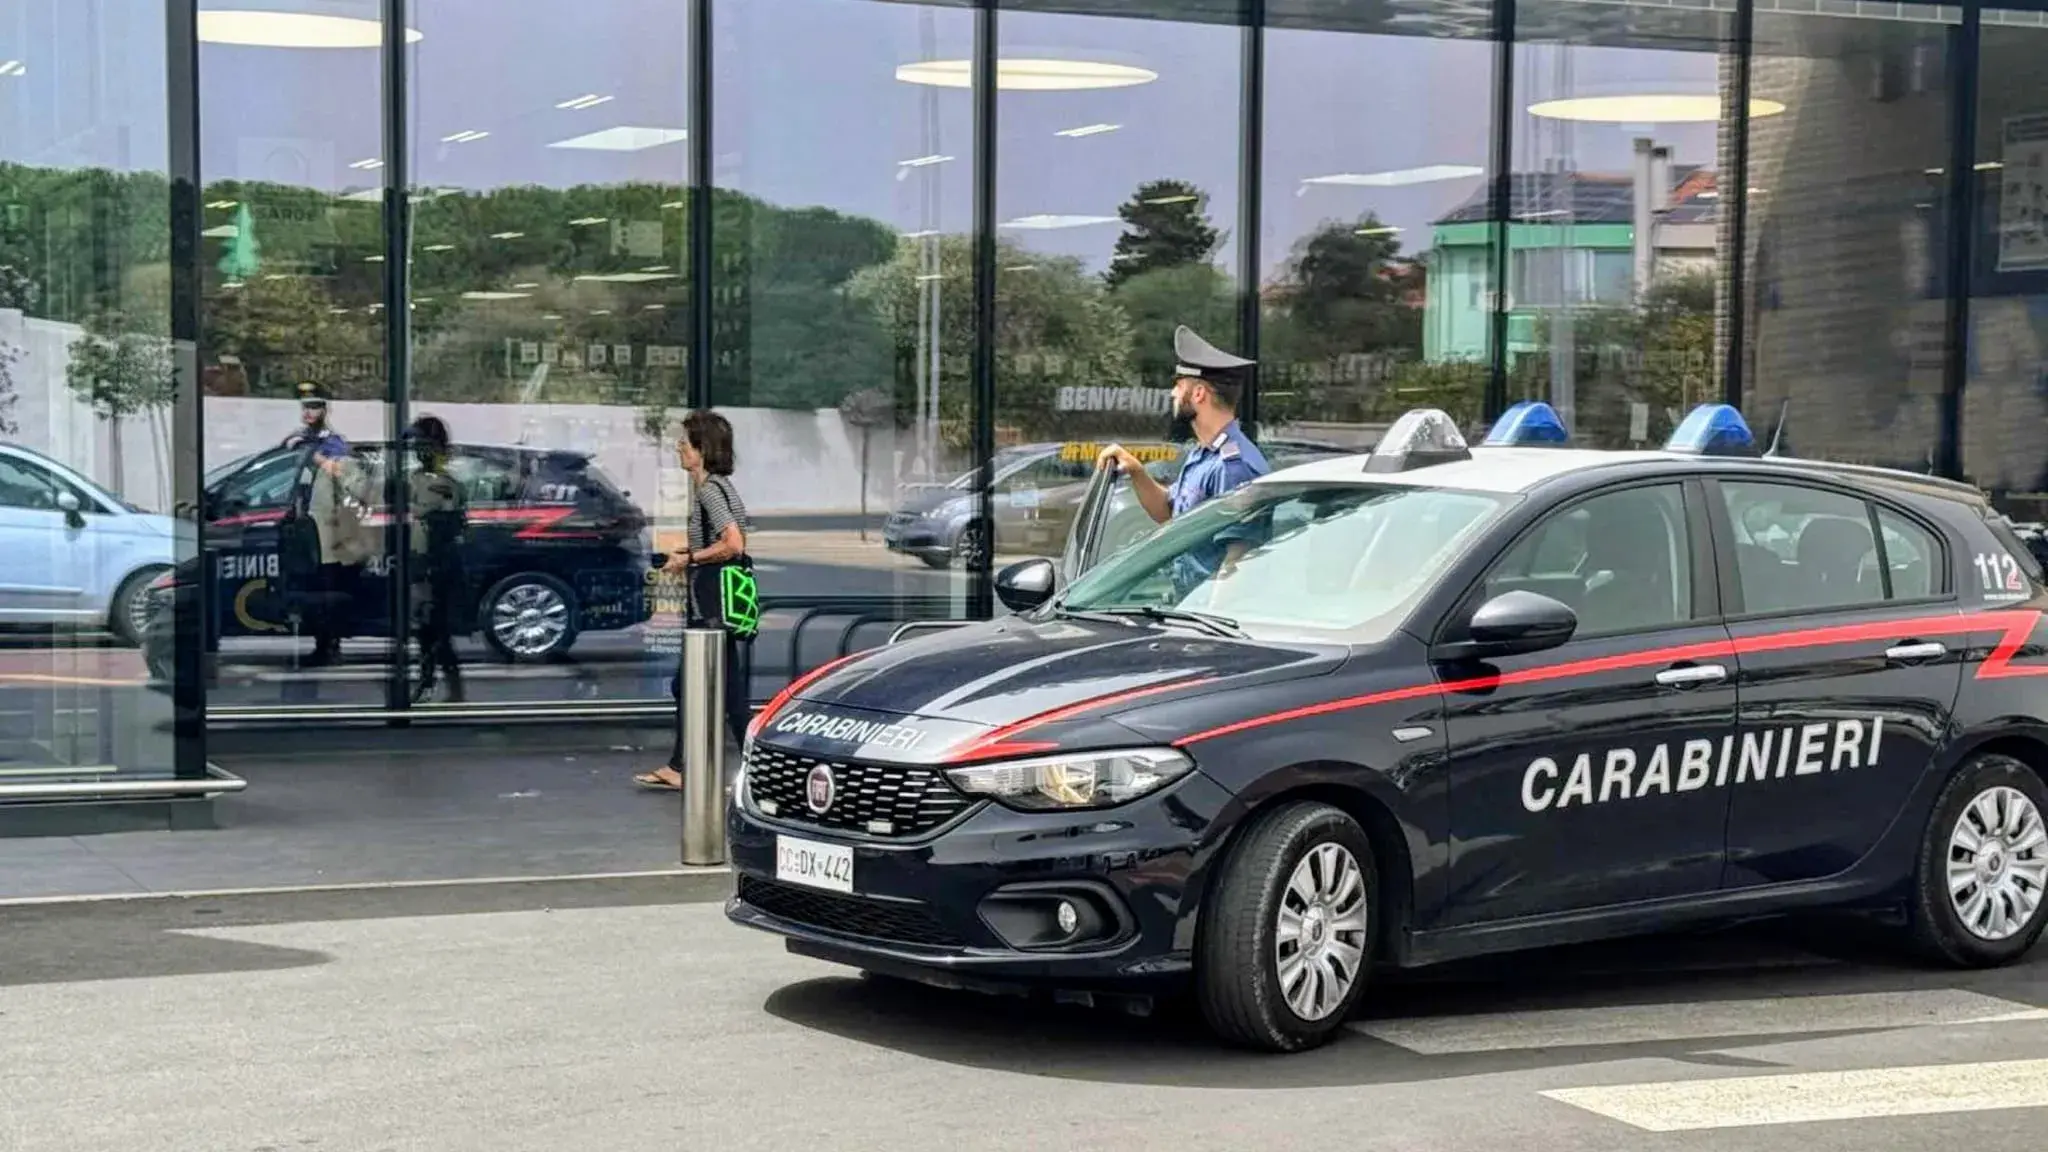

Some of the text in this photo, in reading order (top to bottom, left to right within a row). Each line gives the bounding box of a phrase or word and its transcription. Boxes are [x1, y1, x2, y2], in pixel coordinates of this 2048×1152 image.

[1057, 386, 1172, 415] BENVENUT
[1974, 553, 2022, 590] 112
[776, 712, 928, 750] CARABINIERI
[1521, 716, 1884, 812] CARABINIERI
